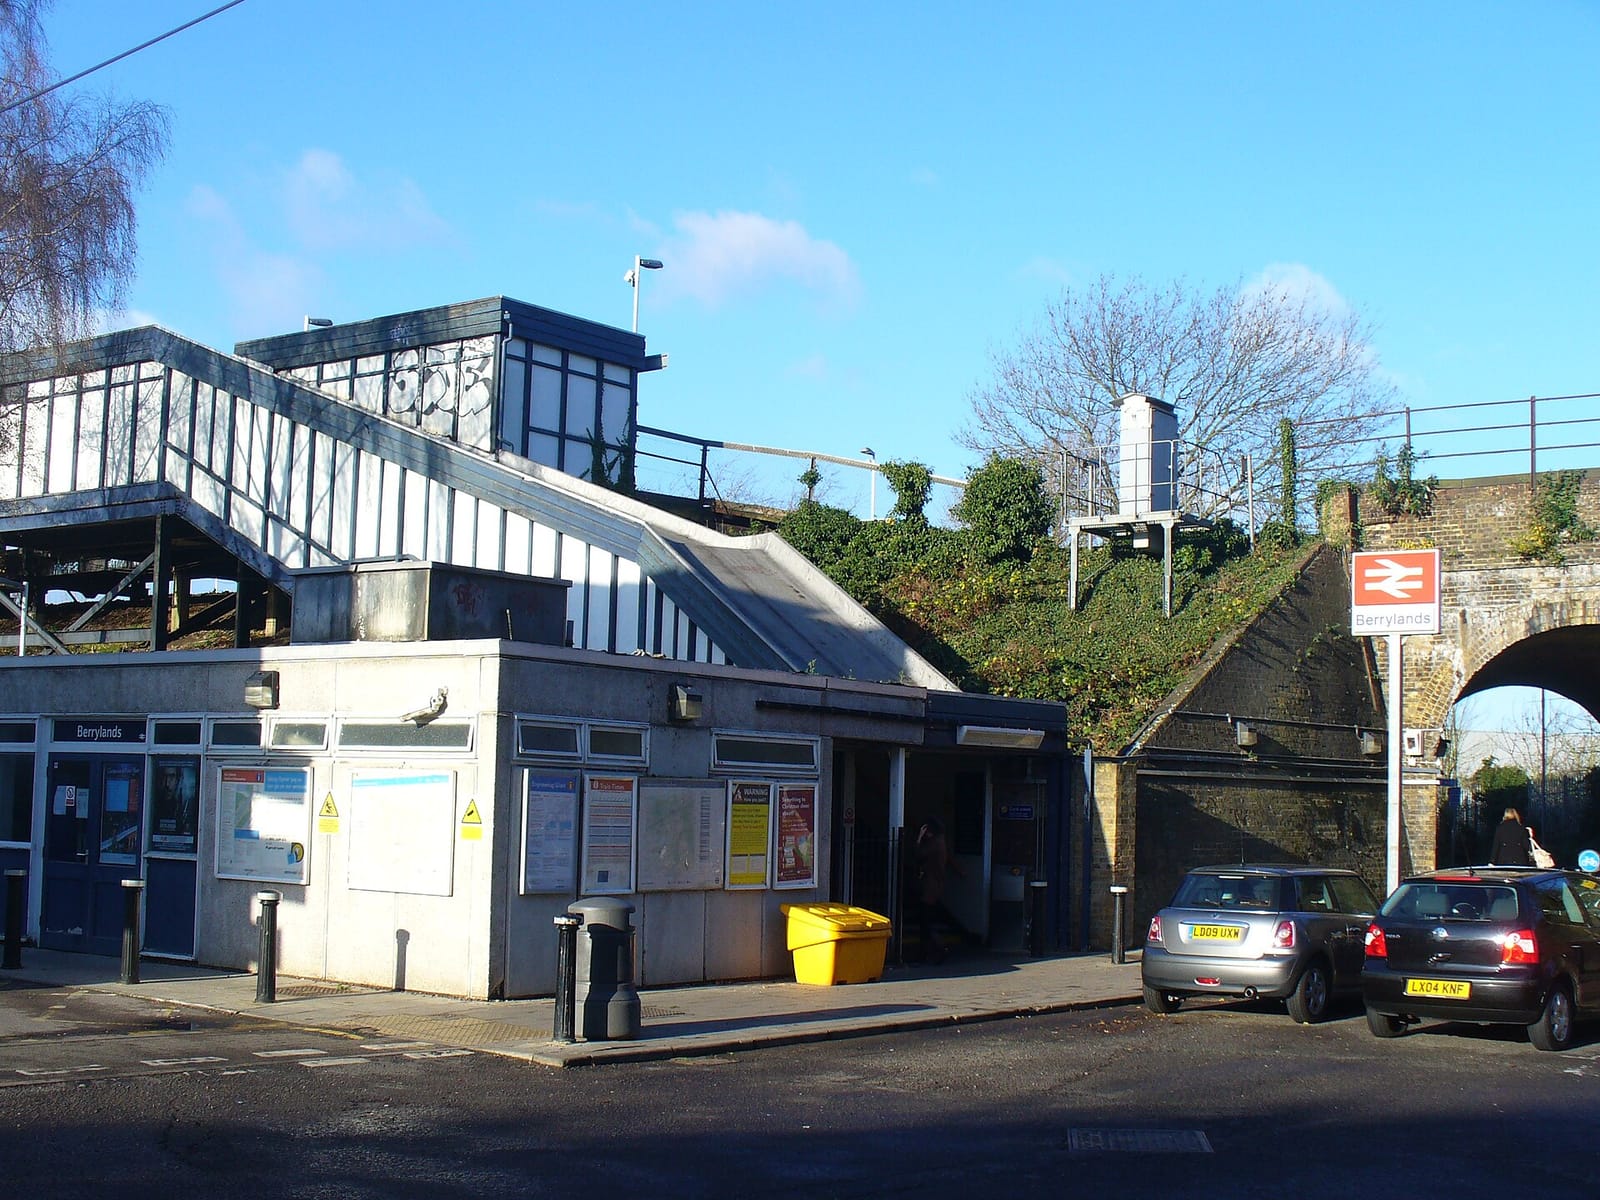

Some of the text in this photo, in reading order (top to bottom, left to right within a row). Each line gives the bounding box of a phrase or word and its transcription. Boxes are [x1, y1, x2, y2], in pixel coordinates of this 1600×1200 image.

[1356, 612, 1431, 627] Berrylands
[77, 725, 122, 741] Berrylands
[743, 787, 768, 795] WARNING
[1193, 927, 1240, 938] LD09 UXW
[1411, 981, 1465, 995] LX04 KNF
